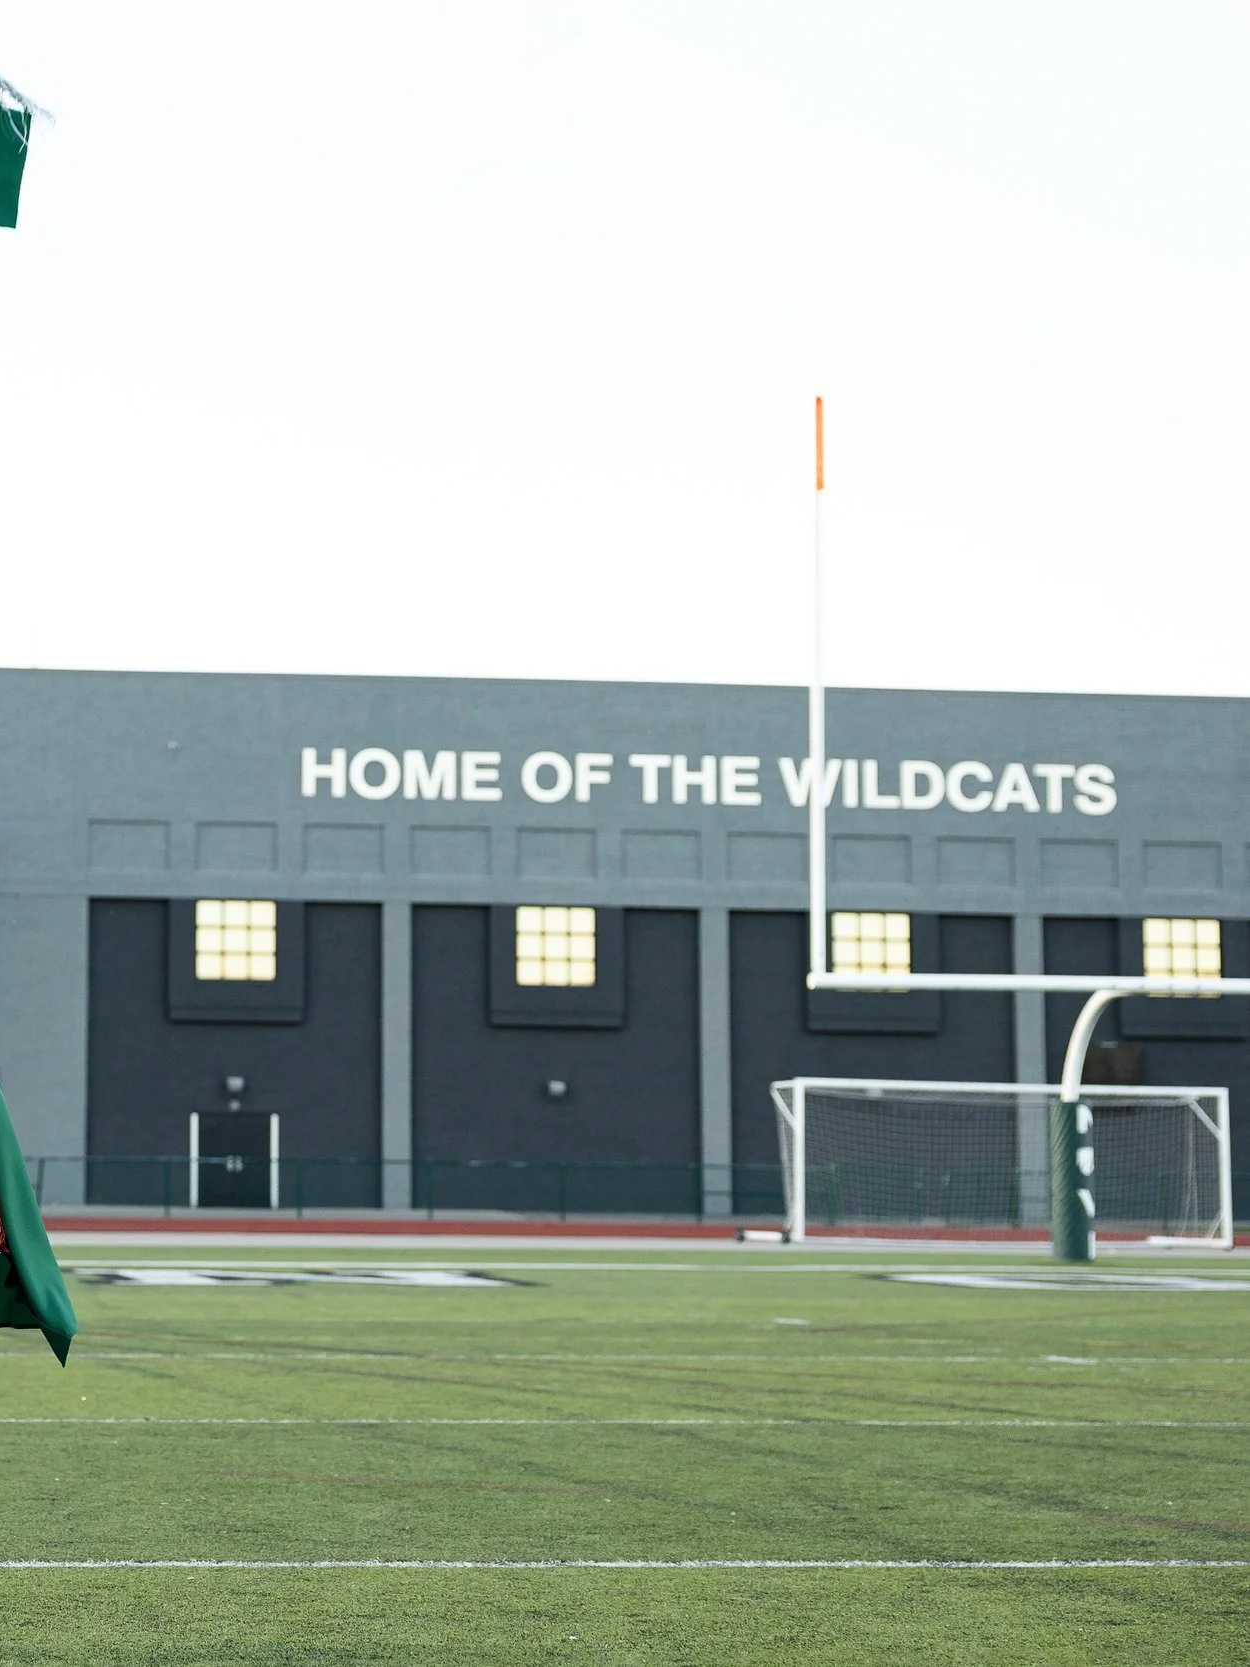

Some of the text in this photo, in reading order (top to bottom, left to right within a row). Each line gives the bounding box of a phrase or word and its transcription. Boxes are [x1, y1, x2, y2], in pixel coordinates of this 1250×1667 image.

[301, 747, 1117, 816] HOME OF THE WILDCATS
